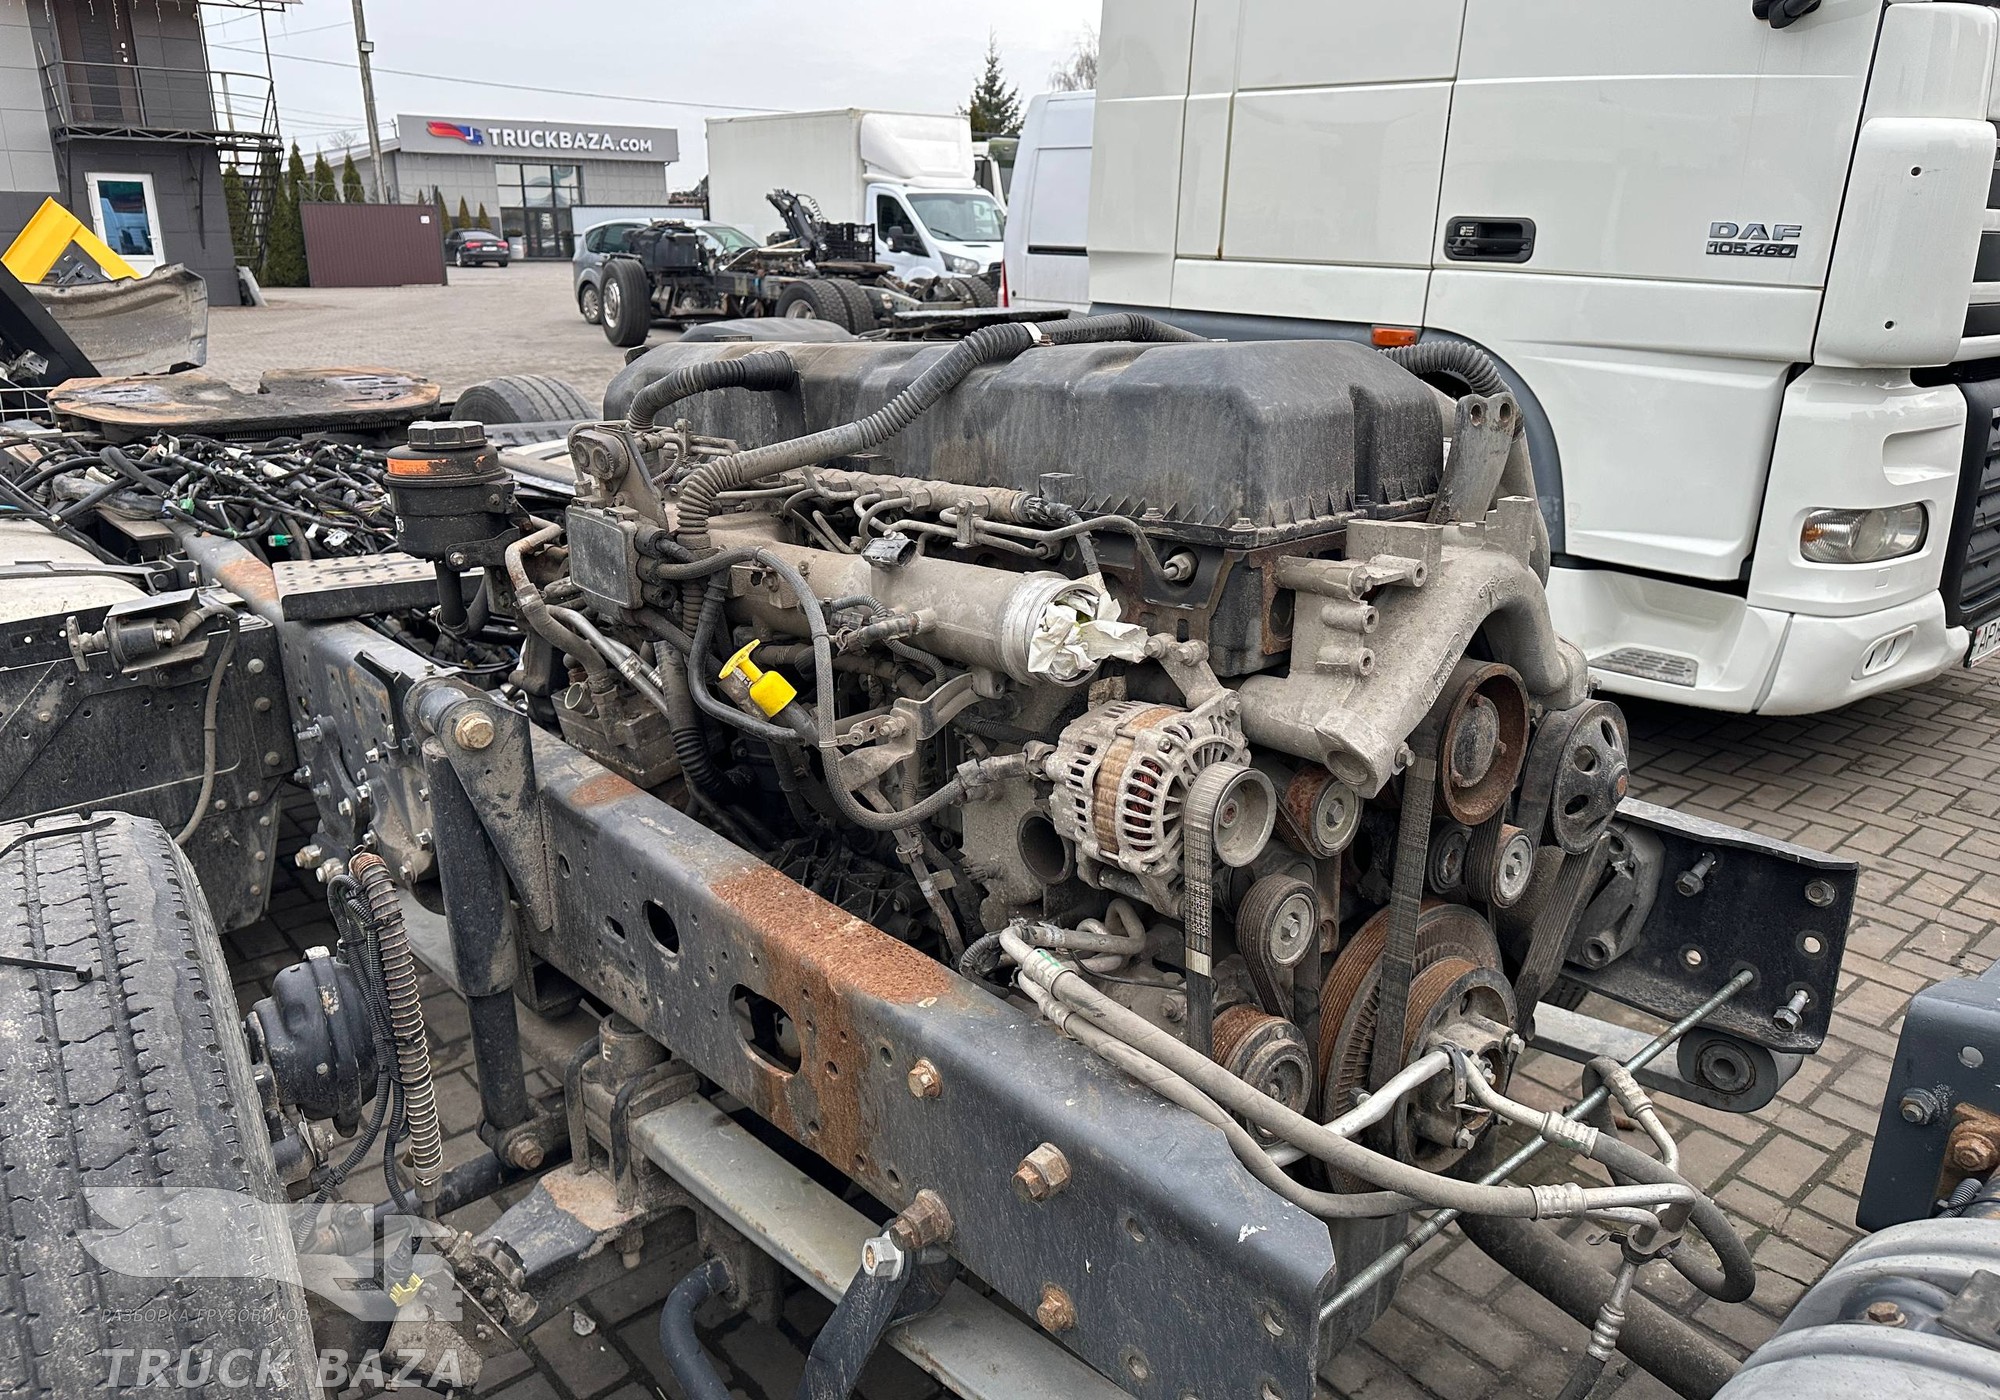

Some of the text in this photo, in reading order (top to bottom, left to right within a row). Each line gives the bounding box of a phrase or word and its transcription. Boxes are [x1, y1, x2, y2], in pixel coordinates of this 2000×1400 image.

[488, 127, 652, 152] TRUCKBAZA.COM
[1709, 222, 1802, 241] DAF
[1707, 241, 1797, 257] 105.460
